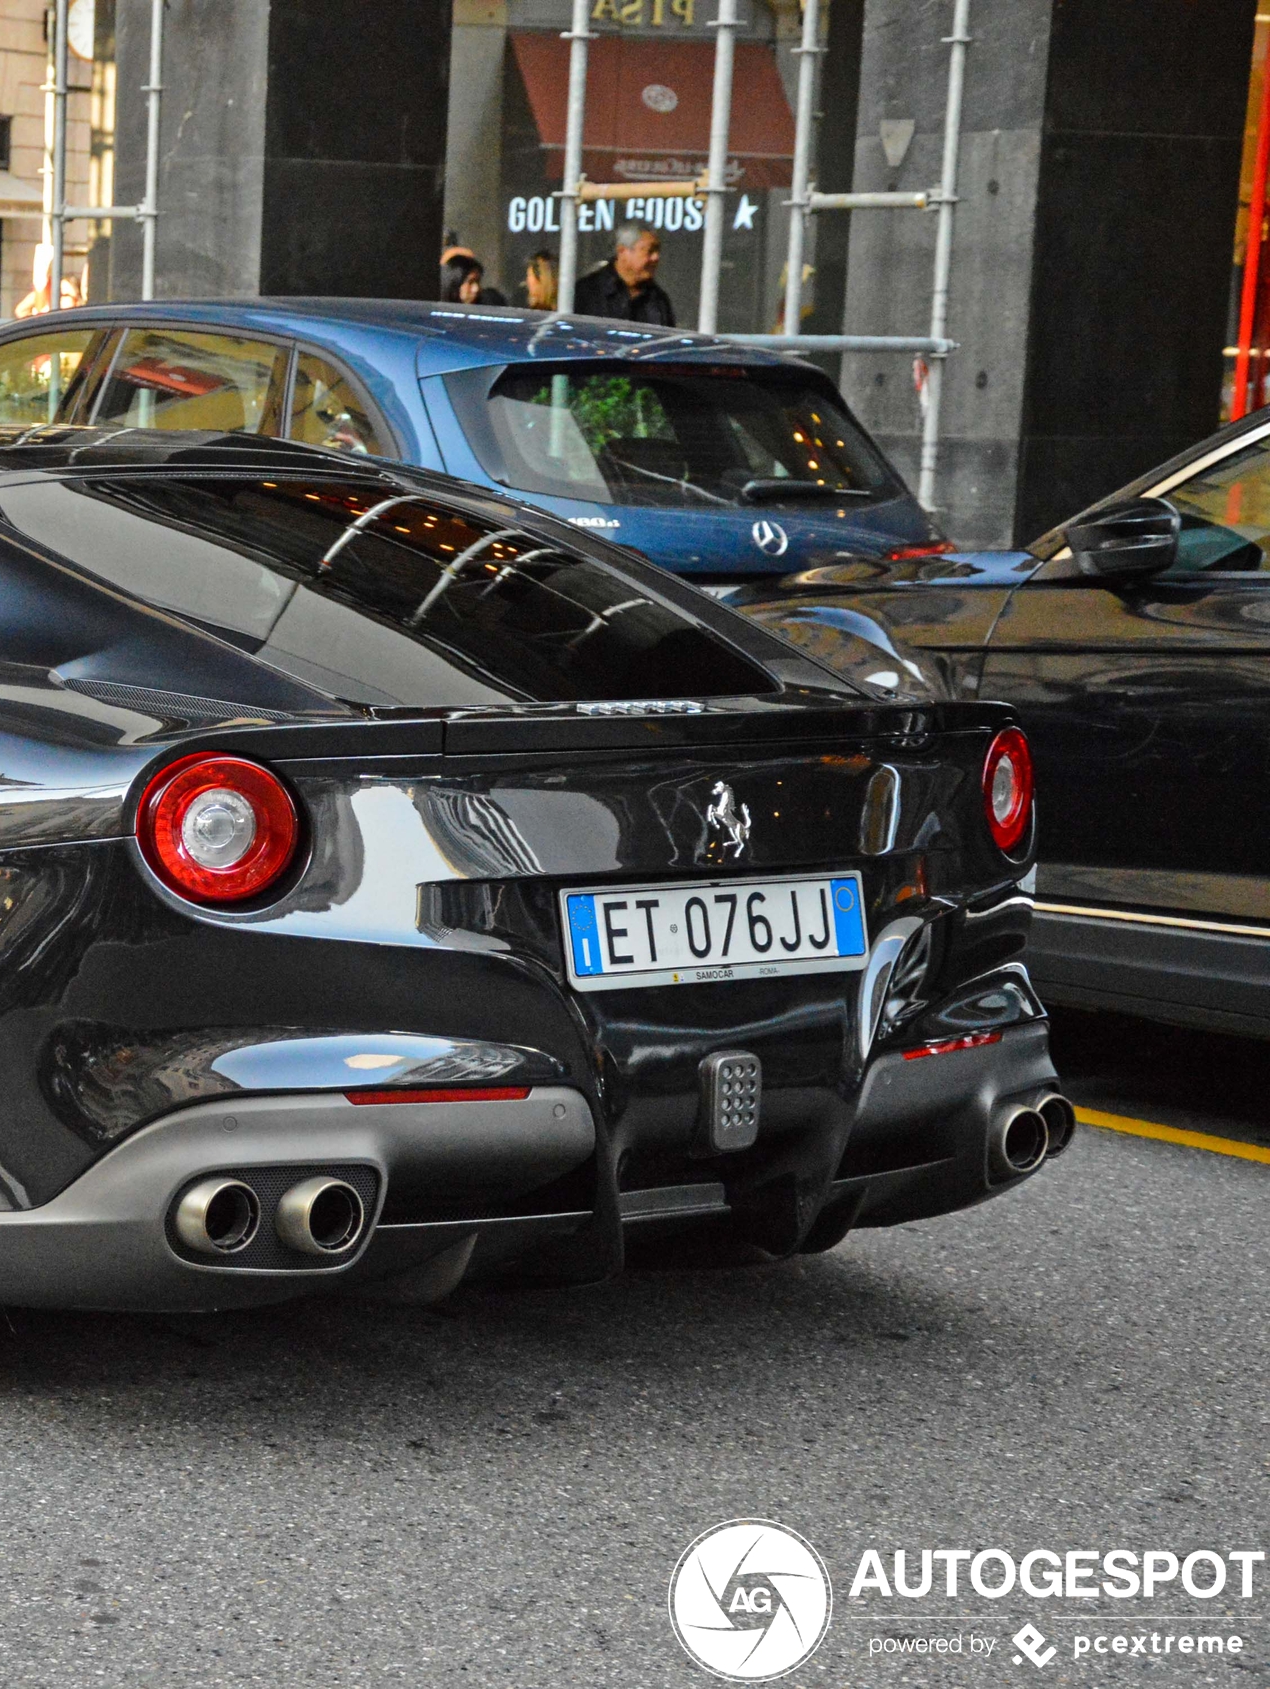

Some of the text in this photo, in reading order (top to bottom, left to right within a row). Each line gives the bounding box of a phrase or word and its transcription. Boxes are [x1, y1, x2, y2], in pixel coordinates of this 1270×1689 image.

[508, 196, 711, 232] GOLEN GOOS
[603, 899, 661, 965] ET
[696, 969, 734, 981] SAMOCAR
